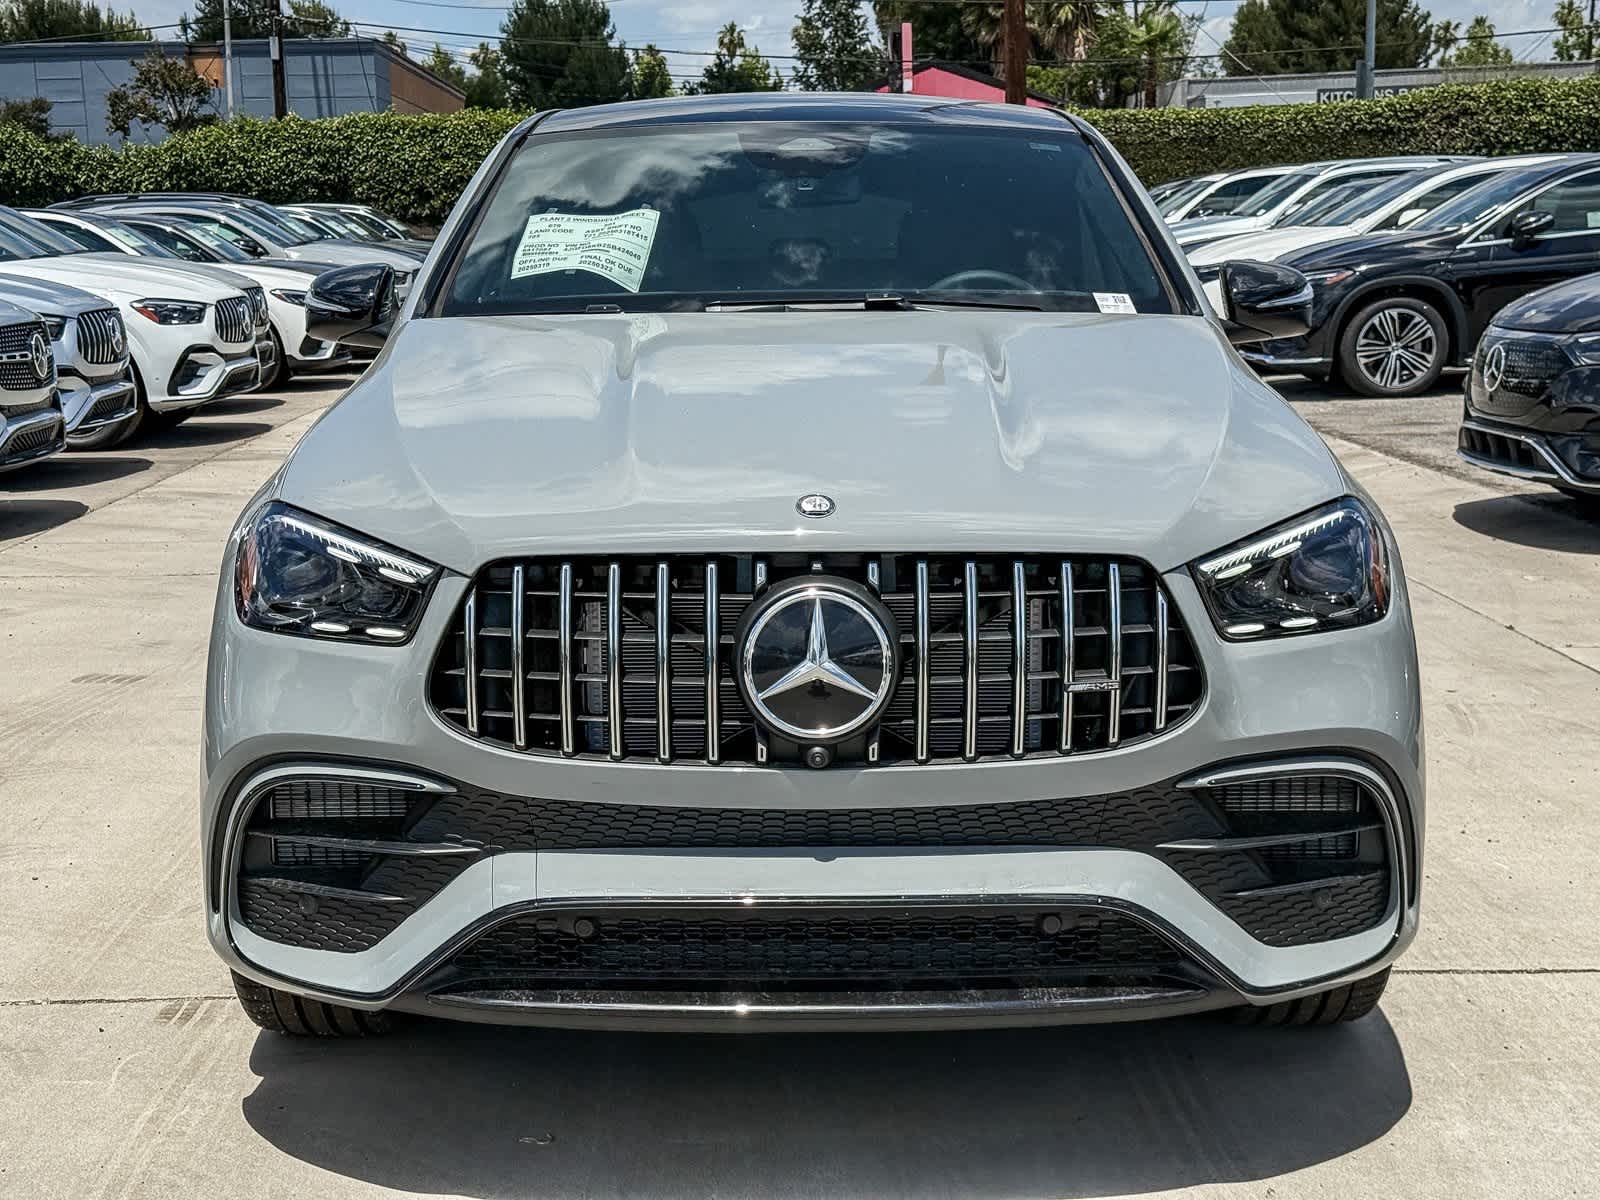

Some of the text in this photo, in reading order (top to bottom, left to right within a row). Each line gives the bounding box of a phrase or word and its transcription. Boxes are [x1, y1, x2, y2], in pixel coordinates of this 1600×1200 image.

[1320, 90, 1394, 104] KITCNS
[518, 256, 551, 266] OFFLINE
[605, 258, 617, 267] OK
[618, 263, 634, 275] DUE
